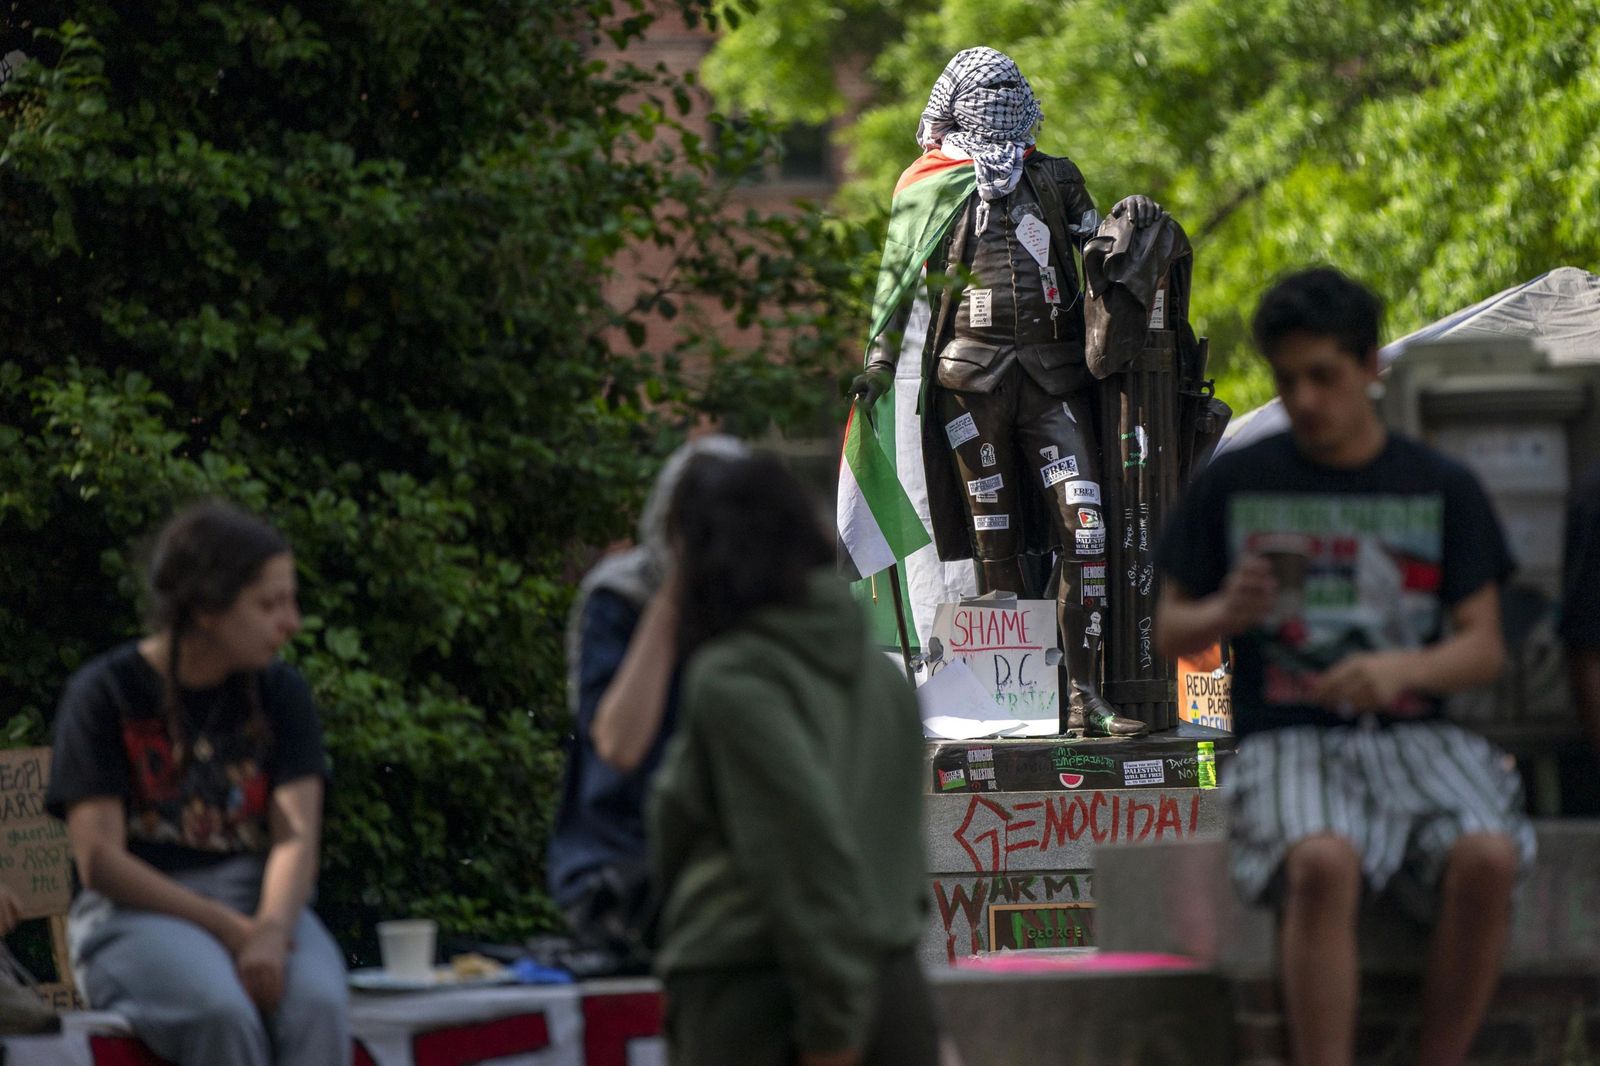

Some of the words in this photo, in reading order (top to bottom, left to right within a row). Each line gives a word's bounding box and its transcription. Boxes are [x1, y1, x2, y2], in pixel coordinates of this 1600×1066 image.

[1043, 459, 1075, 478] FREE
[1073, 487, 1095, 495] FREE
[950, 610, 1032, 646] SHAME
[994, 653, 1037, 686] D.C.
[1186, 673, 1221, 696] REDUCE
[1208, 698, 1232, 715] PLASTI
[1124, 766, 1162, 774] PALESTINE
[1166, 758, 1197, 769] Dives
[0, 758, 48, 791] EOPL
[970, 768, 995, 780] PALESTINE
[934, 876, 1095, 933] WARM
[1027, 926, 1082, 939] GEORGE
